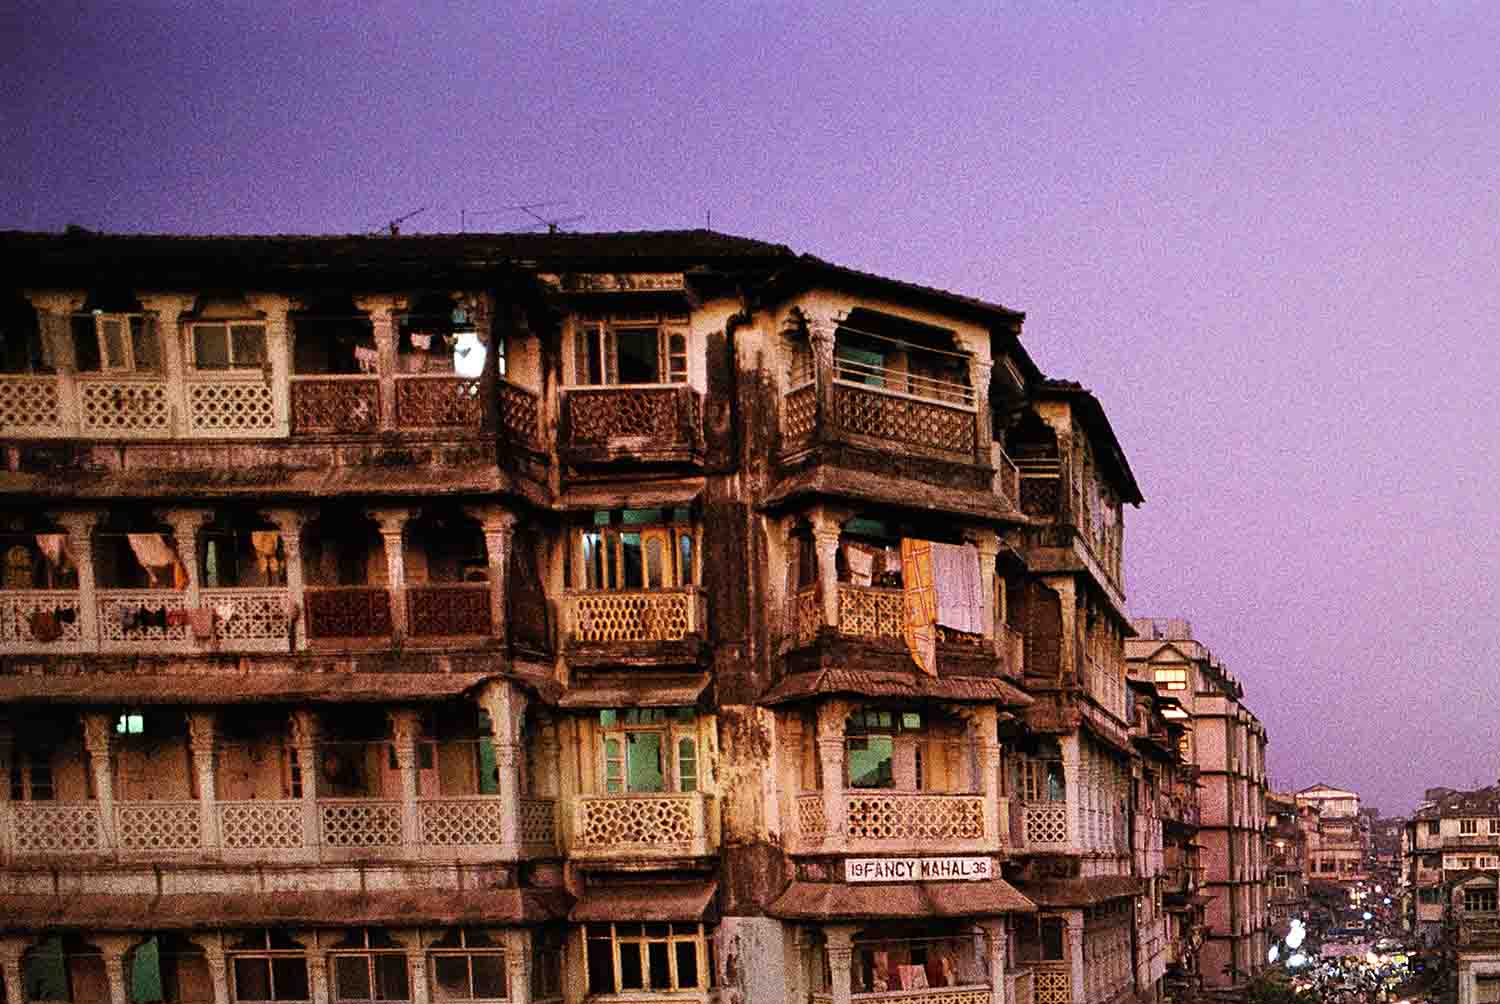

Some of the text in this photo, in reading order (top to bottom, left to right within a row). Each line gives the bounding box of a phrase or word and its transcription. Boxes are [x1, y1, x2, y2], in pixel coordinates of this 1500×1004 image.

[851, 859, 987, 878] 19 FANCY MAHAL 36
